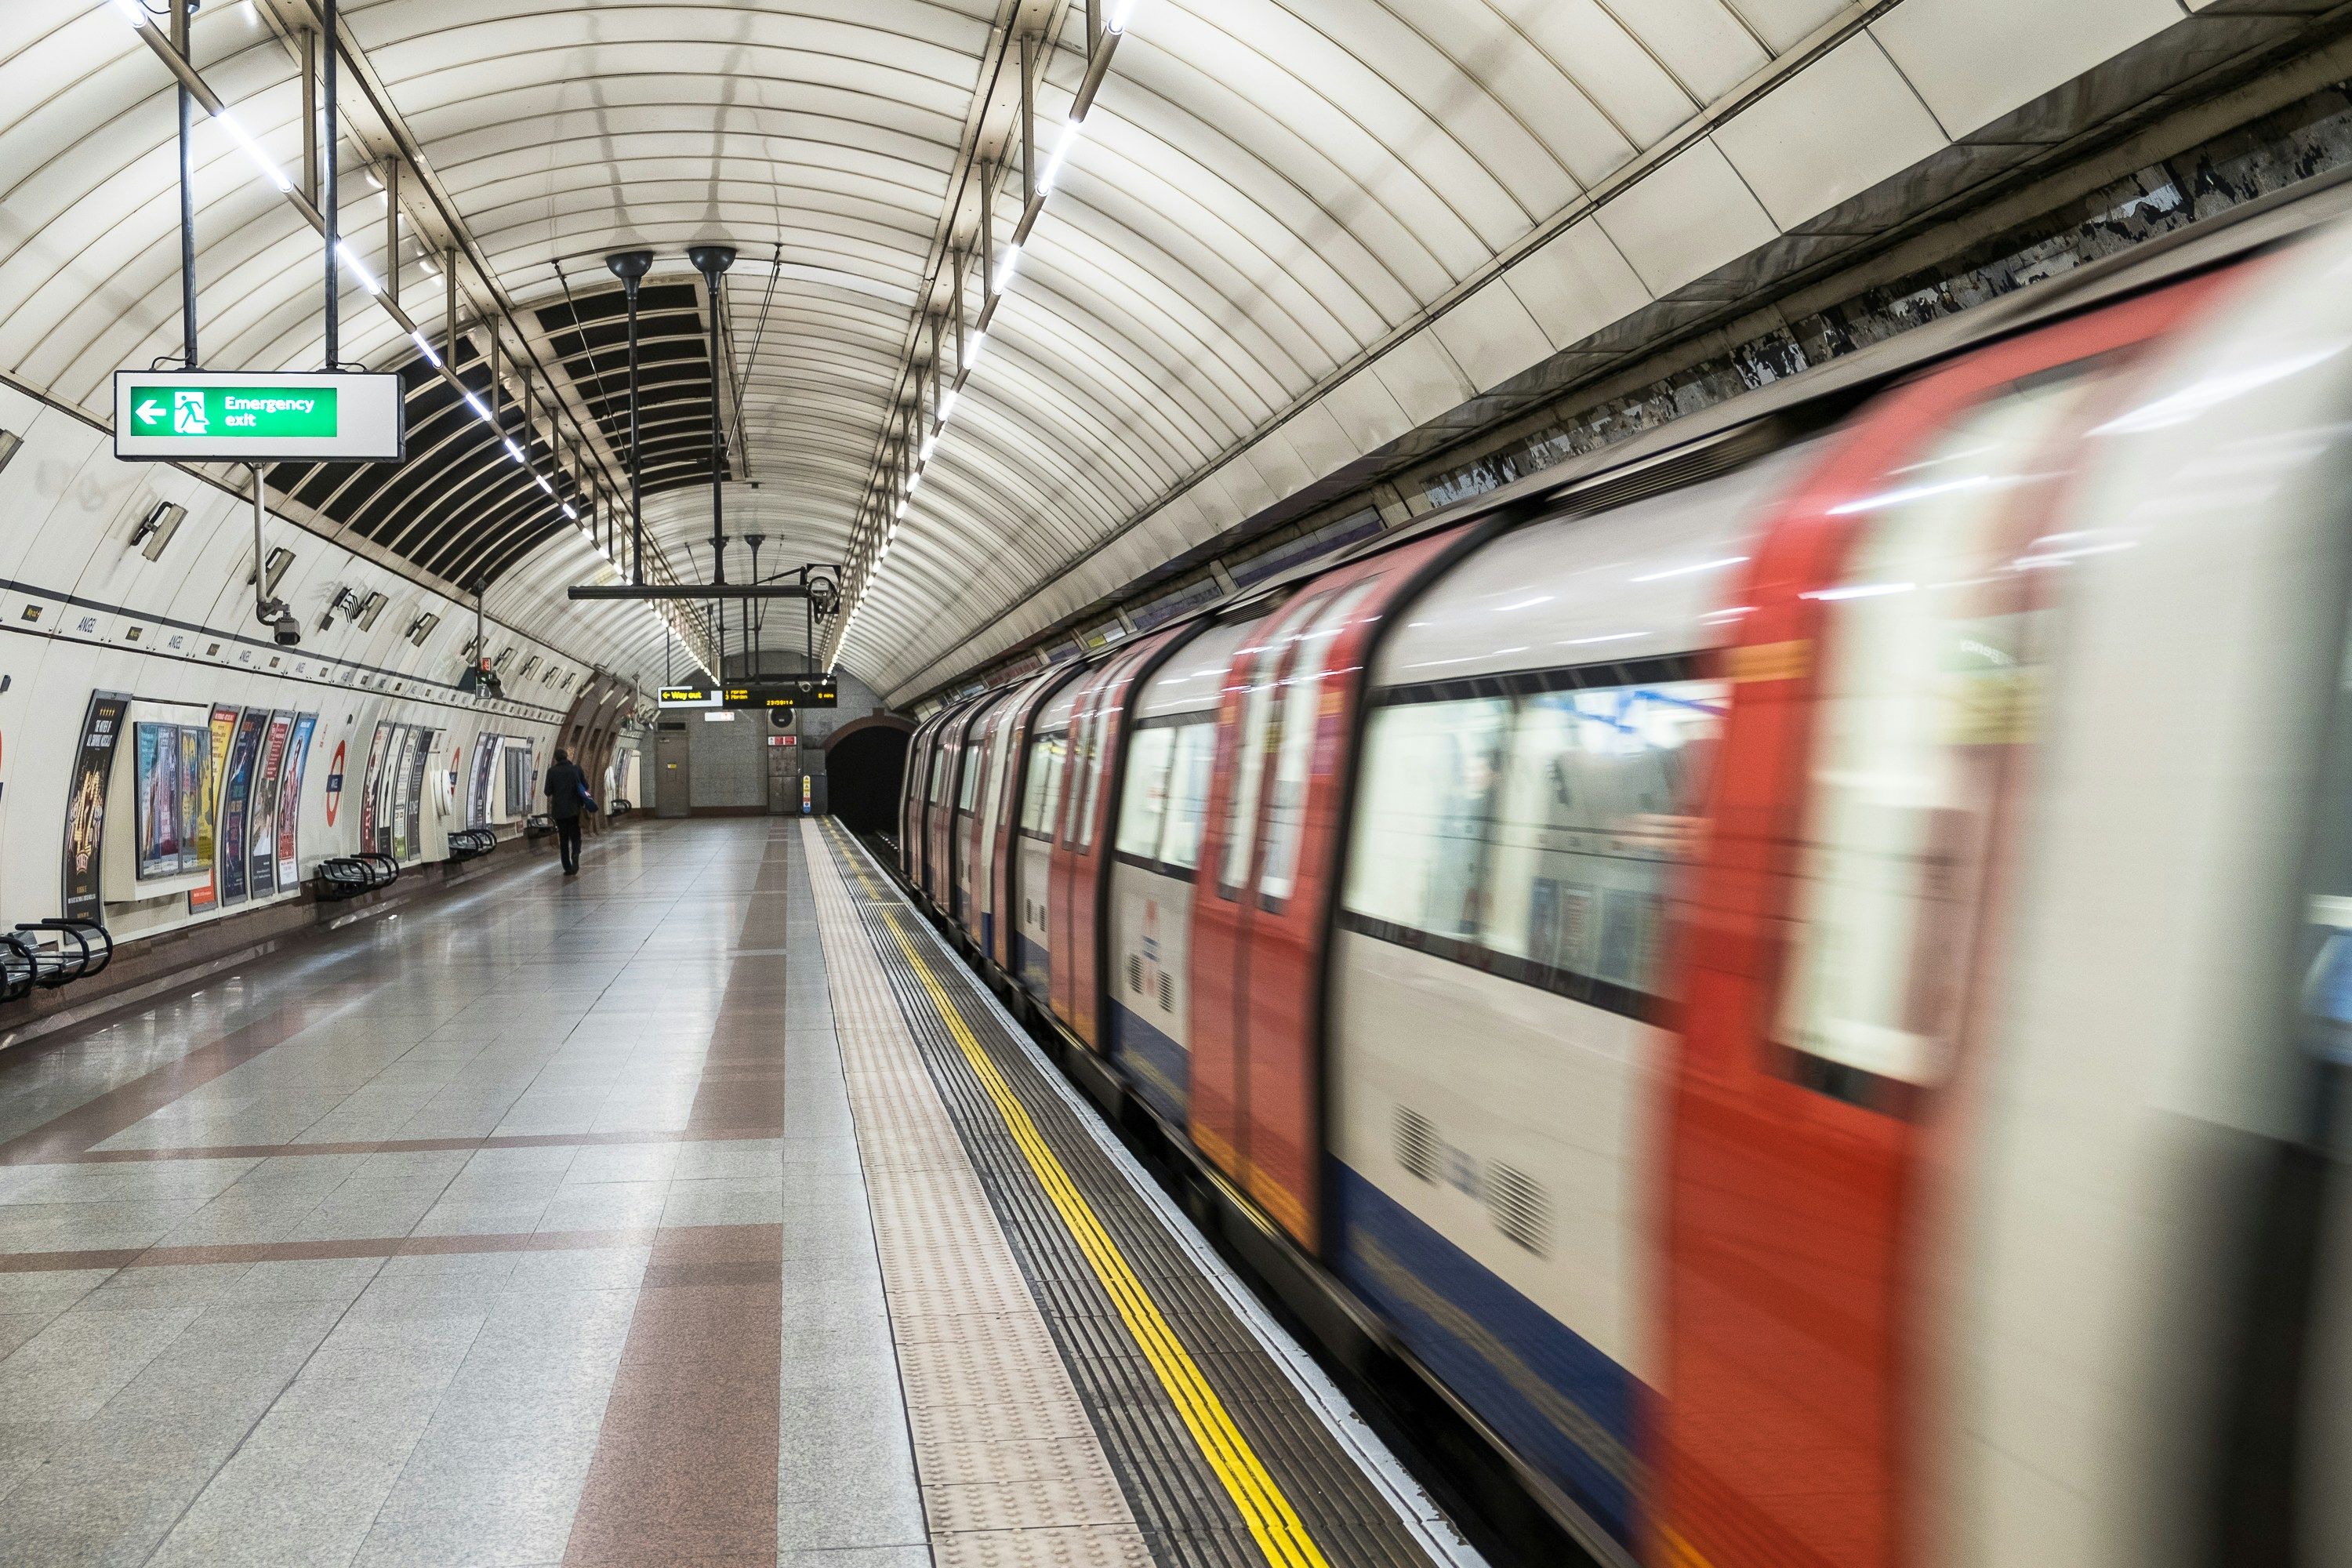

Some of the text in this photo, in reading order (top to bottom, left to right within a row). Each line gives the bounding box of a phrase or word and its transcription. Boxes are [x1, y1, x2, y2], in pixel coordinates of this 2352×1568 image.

[225, 396, 314, 413] Emergency
[225, 412, 256, 426] exit
[76, 616, 97, 633] ANGEL
[671, 691, 687, 700] Way
